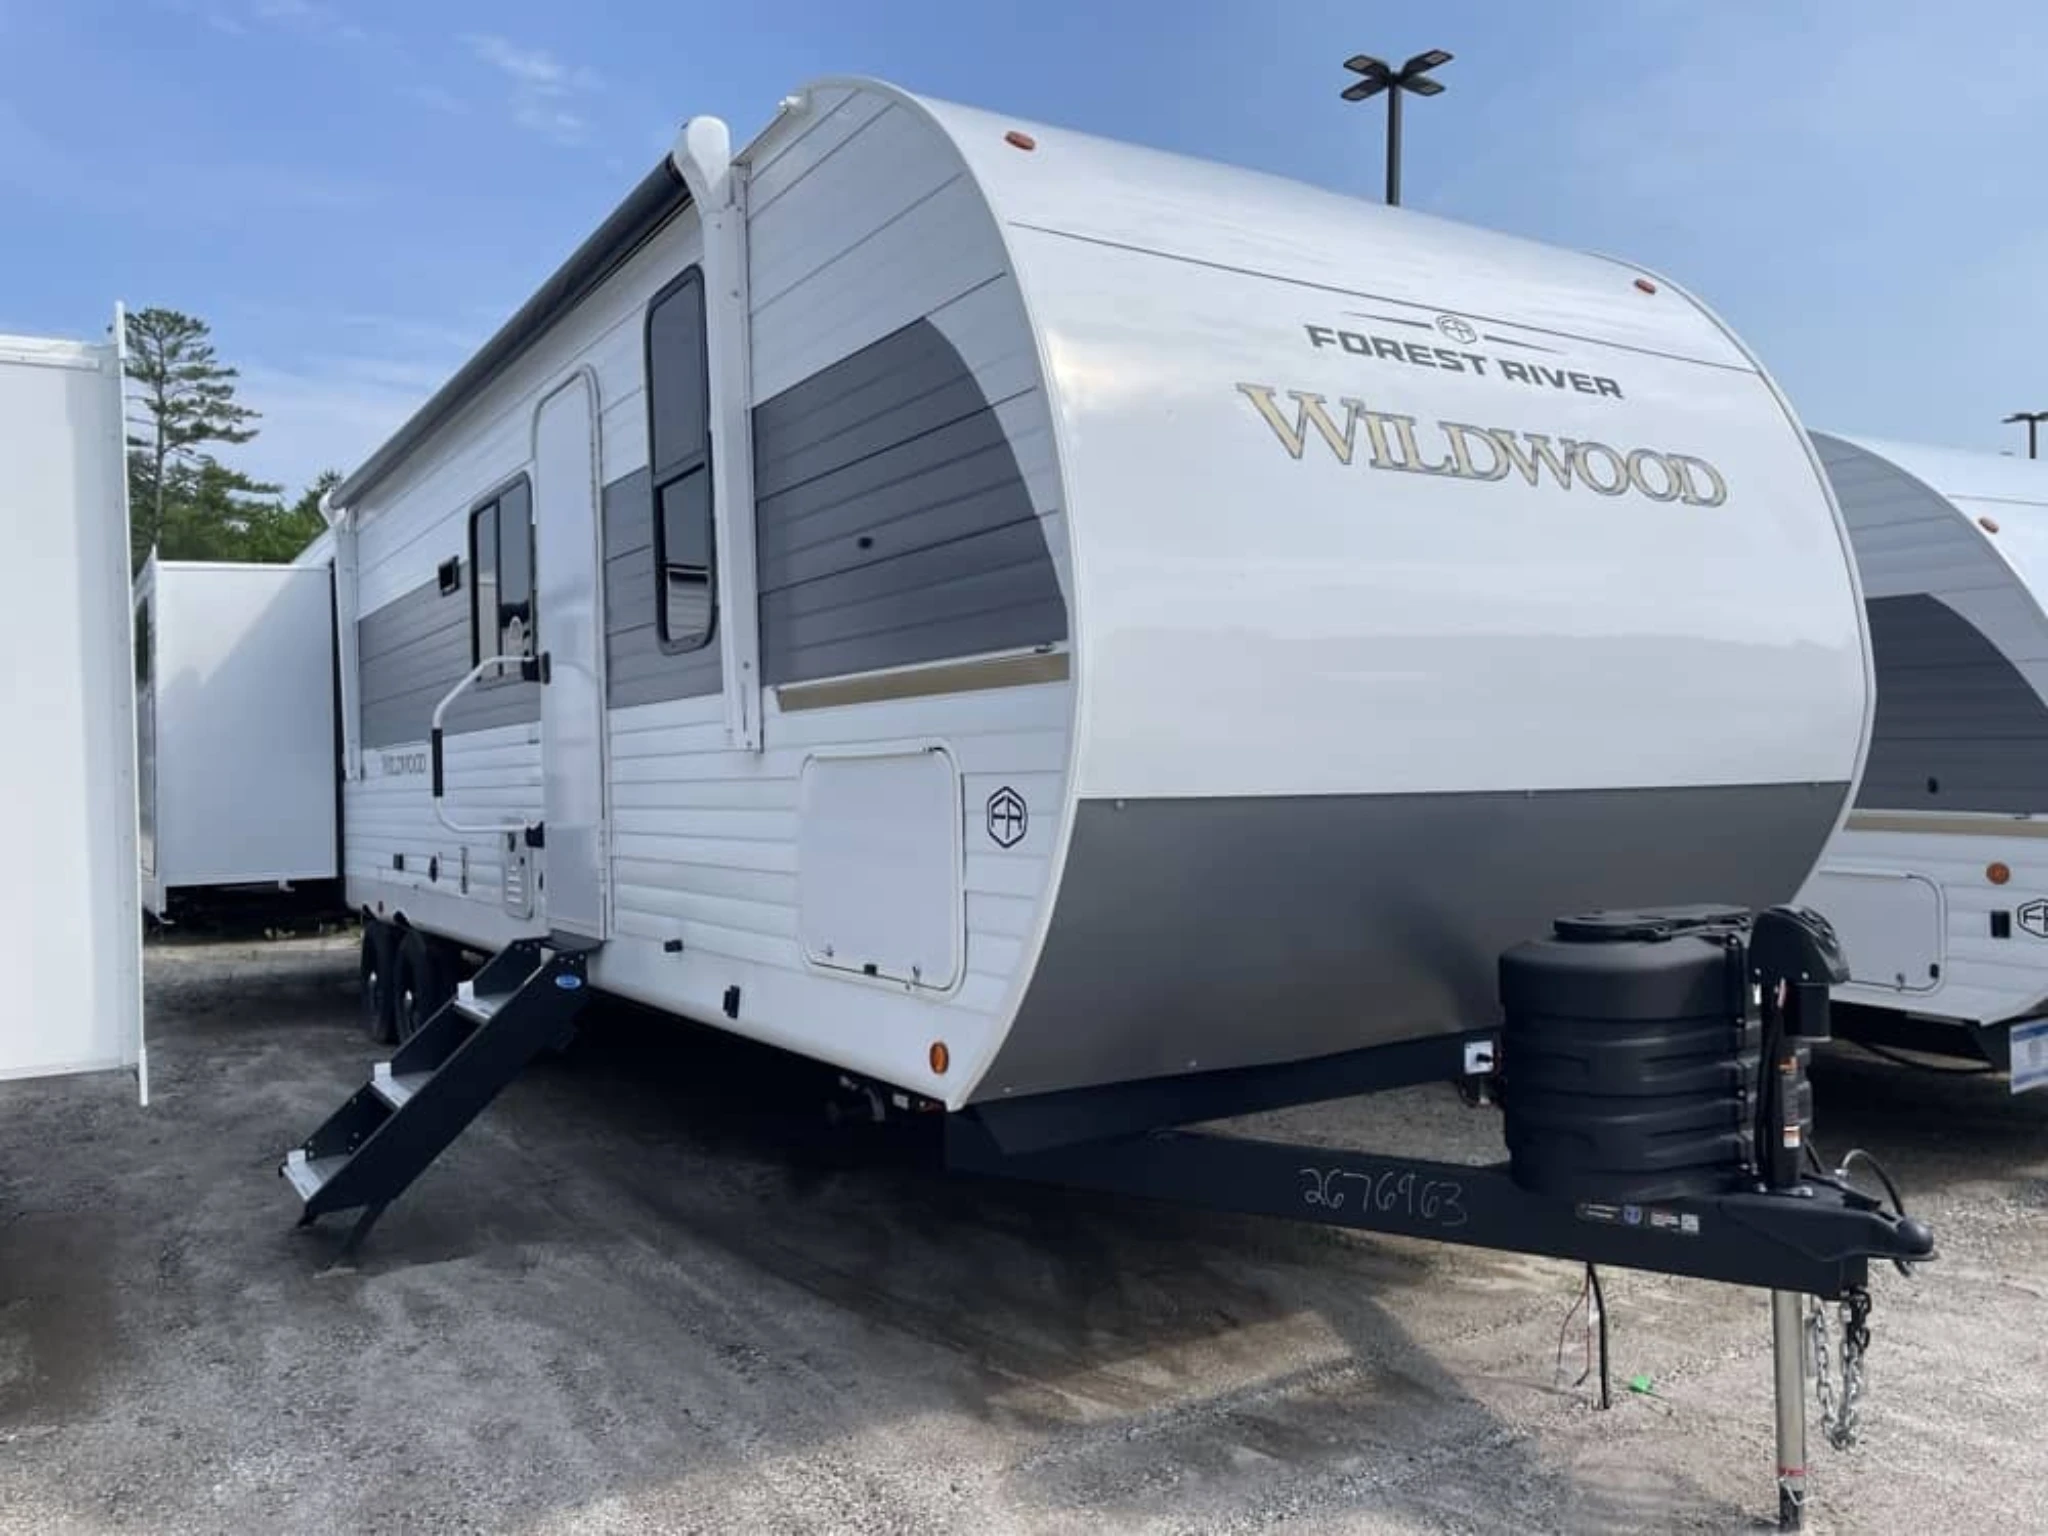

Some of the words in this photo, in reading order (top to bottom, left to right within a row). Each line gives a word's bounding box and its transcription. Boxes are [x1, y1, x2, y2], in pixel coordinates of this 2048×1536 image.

[1303, 324, 1487, 376] FOREST
[1497, 357, 1625, 399] RIVER
[1237, 382, 1728, 508] WILDWOOD
[1299, 1167, 1469, 1226] 2676963
